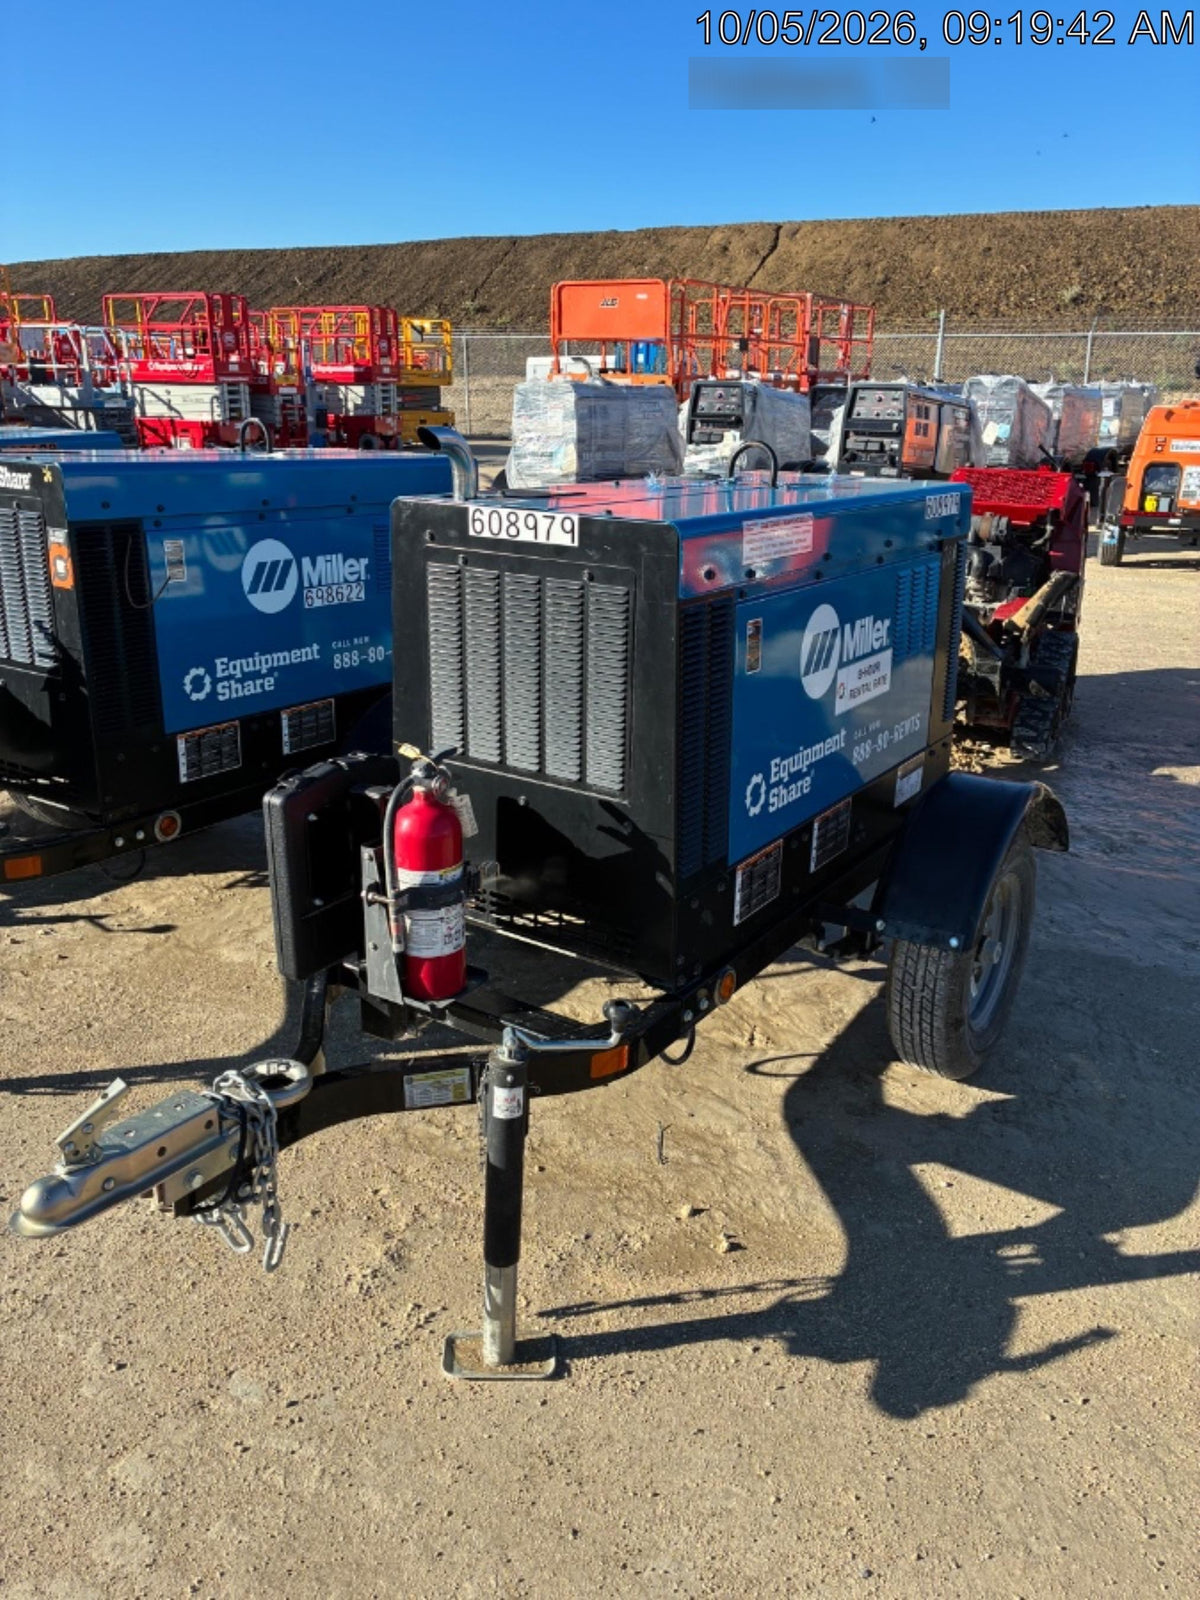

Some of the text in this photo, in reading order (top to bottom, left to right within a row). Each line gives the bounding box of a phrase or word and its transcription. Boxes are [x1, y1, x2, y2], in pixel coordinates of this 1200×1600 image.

[471, 508, 575, 545] 608979
[302, 553, 369, 588] Miller
[304, 582, 364, 607] 698622
[843, 615, 891, 662] Miller
[215, 643, 320, 678] Equipment
[333, 645, 393, 670] 888-80-
[216, 676, 275, 701] Share
[770, 728, 846, 784] Equipment
[852, 712, 920, 765] 888-80-RENTS
[768, 776, 812, 813] Share
